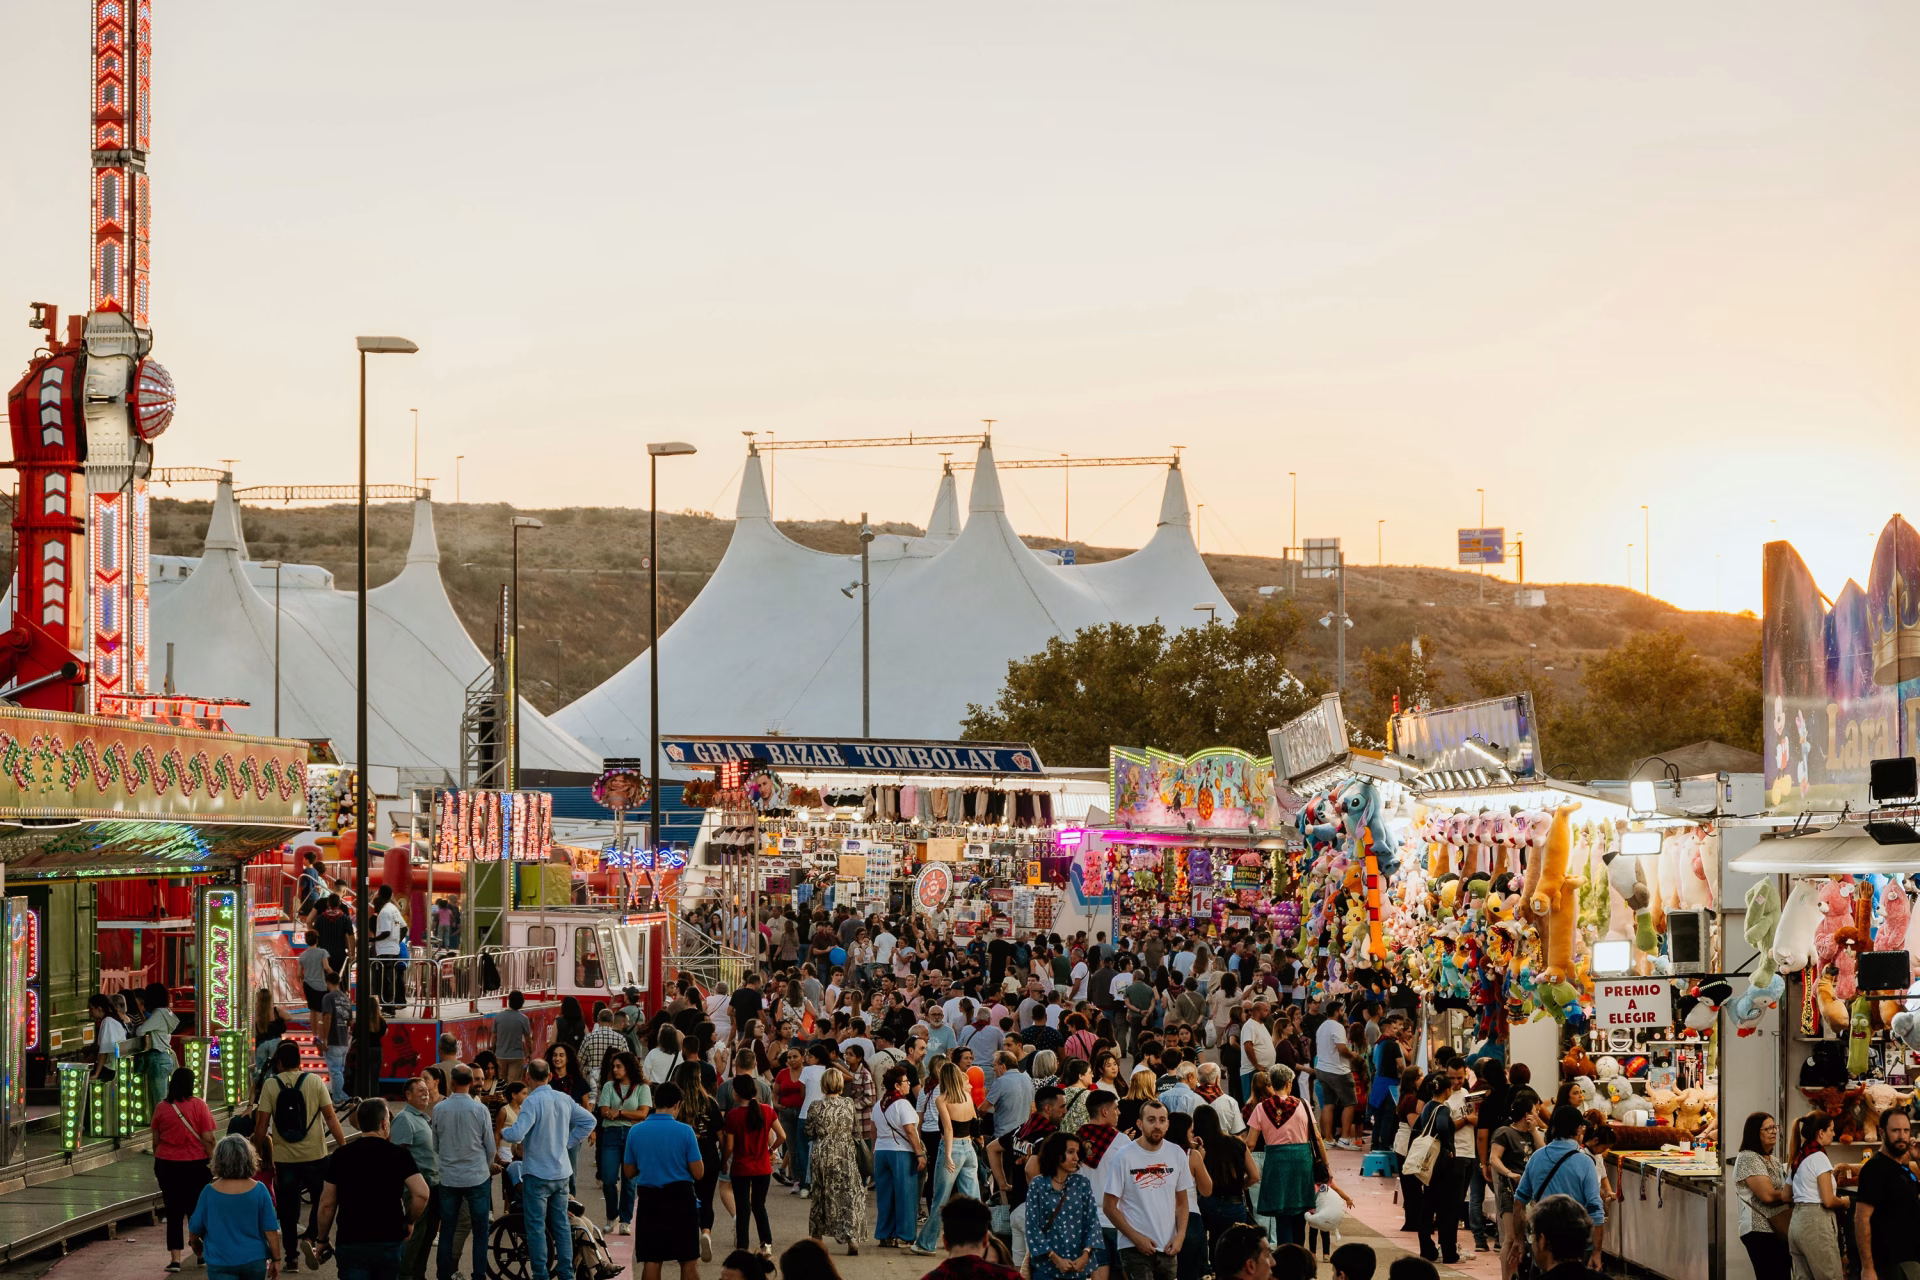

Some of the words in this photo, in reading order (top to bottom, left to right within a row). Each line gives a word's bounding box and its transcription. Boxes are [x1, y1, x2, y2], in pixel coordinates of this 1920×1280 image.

[1826, 703, 1890, 770] Lara
[693, 743, 754, 762] GRAN
[766, 745, 845, 765] BAZAR
[855, 746, 1001, 770] TOMBOLAY
[439, 791, 552, 862] ALCATRAZ
[1234, 871, 1260, 880] PREMIOS
[1193, 892, 1212, 911] 1€
[211, 926, 231, 1027] MIAMI
[1604, 984, 1661, 997] PREMIO
[1628, 999, 1637, 1010] A
[1609, 1012, 1656, 1024] ELEGIR
